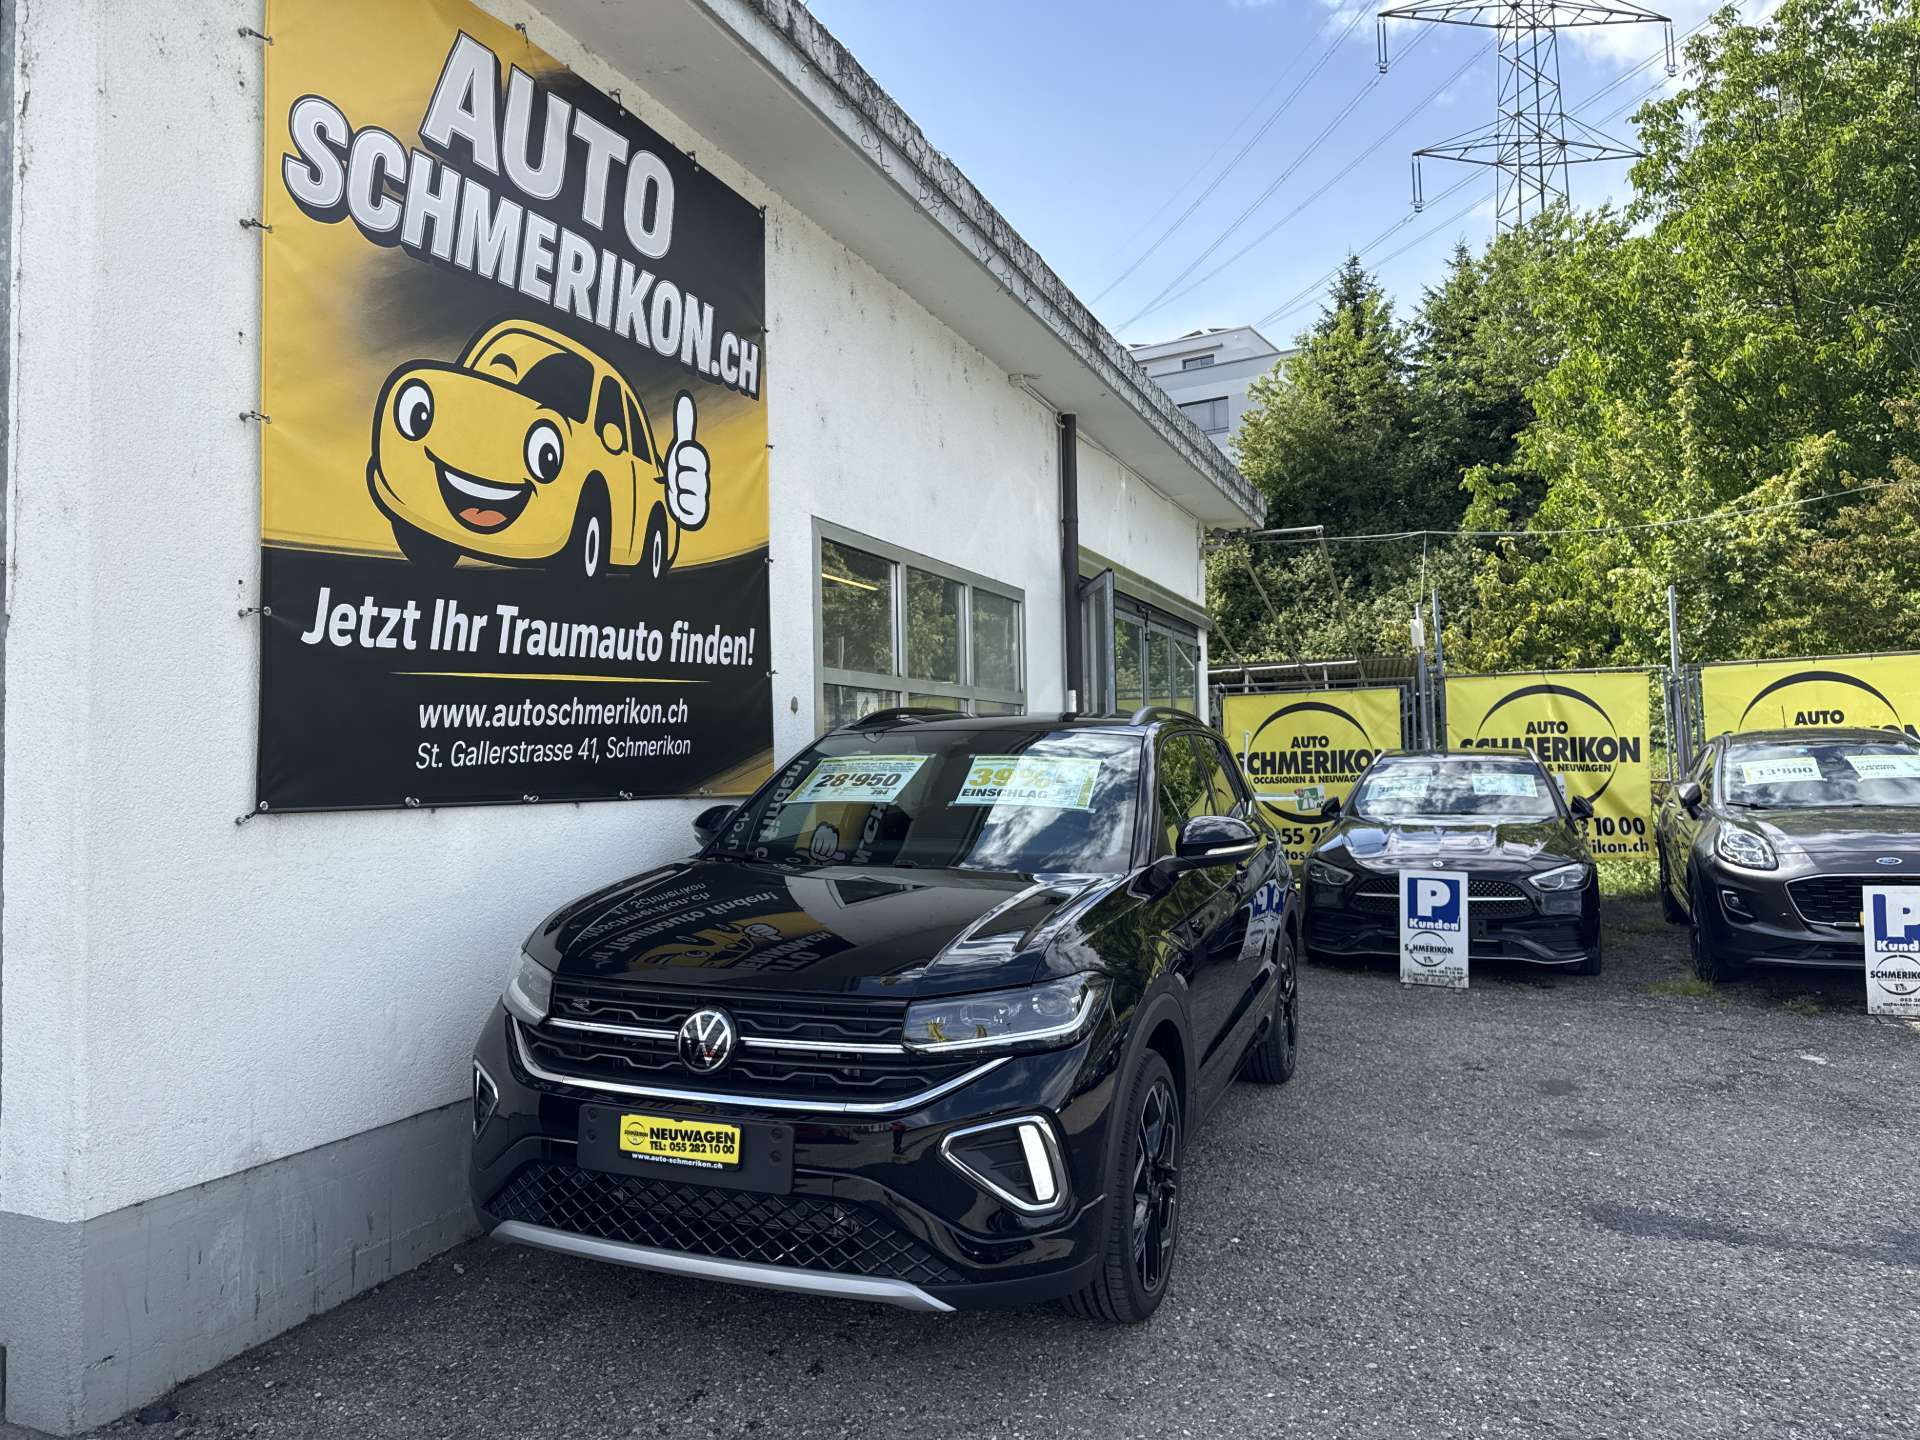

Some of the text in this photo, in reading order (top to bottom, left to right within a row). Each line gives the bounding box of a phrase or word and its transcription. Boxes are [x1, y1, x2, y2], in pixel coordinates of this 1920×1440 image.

[420, 33, 675, 259] AUTO
[285, 98, 760, 394] SCHMERIKON.CH
[301, 586, 756, 667] Jetzt Ihr Traumauto finden!
[418, 698, 688, 730] www.autoschmerikon.ch
[1794, 710, 1844, 726] AUTO
[1526, 720, 1568, 736] AUTO
[1290, 736, 1330, 749] AUTO
[416, 736, 690, 770] St. Gallerstrasse 41, Schmerikon
[1236, 749, 1384, 774] SCHMERIKO
[1558, 763, 1612, 773] NEUWAGEN
[814, 773, 902, 788] 28'950
[1254, 776, 1306, 785] OCCASIONEN
[961, 788, 1049, 800] EINSCHLAG
[1594, 816, 1615, 836] 10
[1618, 816, 1646, 836] 00
[1417, 880, 1450, 916] P
[1408, 918, 1459, 931] Kunden
[650, 1128, 736, 1144] NEUWAGEN
[650, 1141, 735, 1154] TEL: 055 282 10 00
[632, 1153, 723, 1169] www.auto-schmerikon.ch
